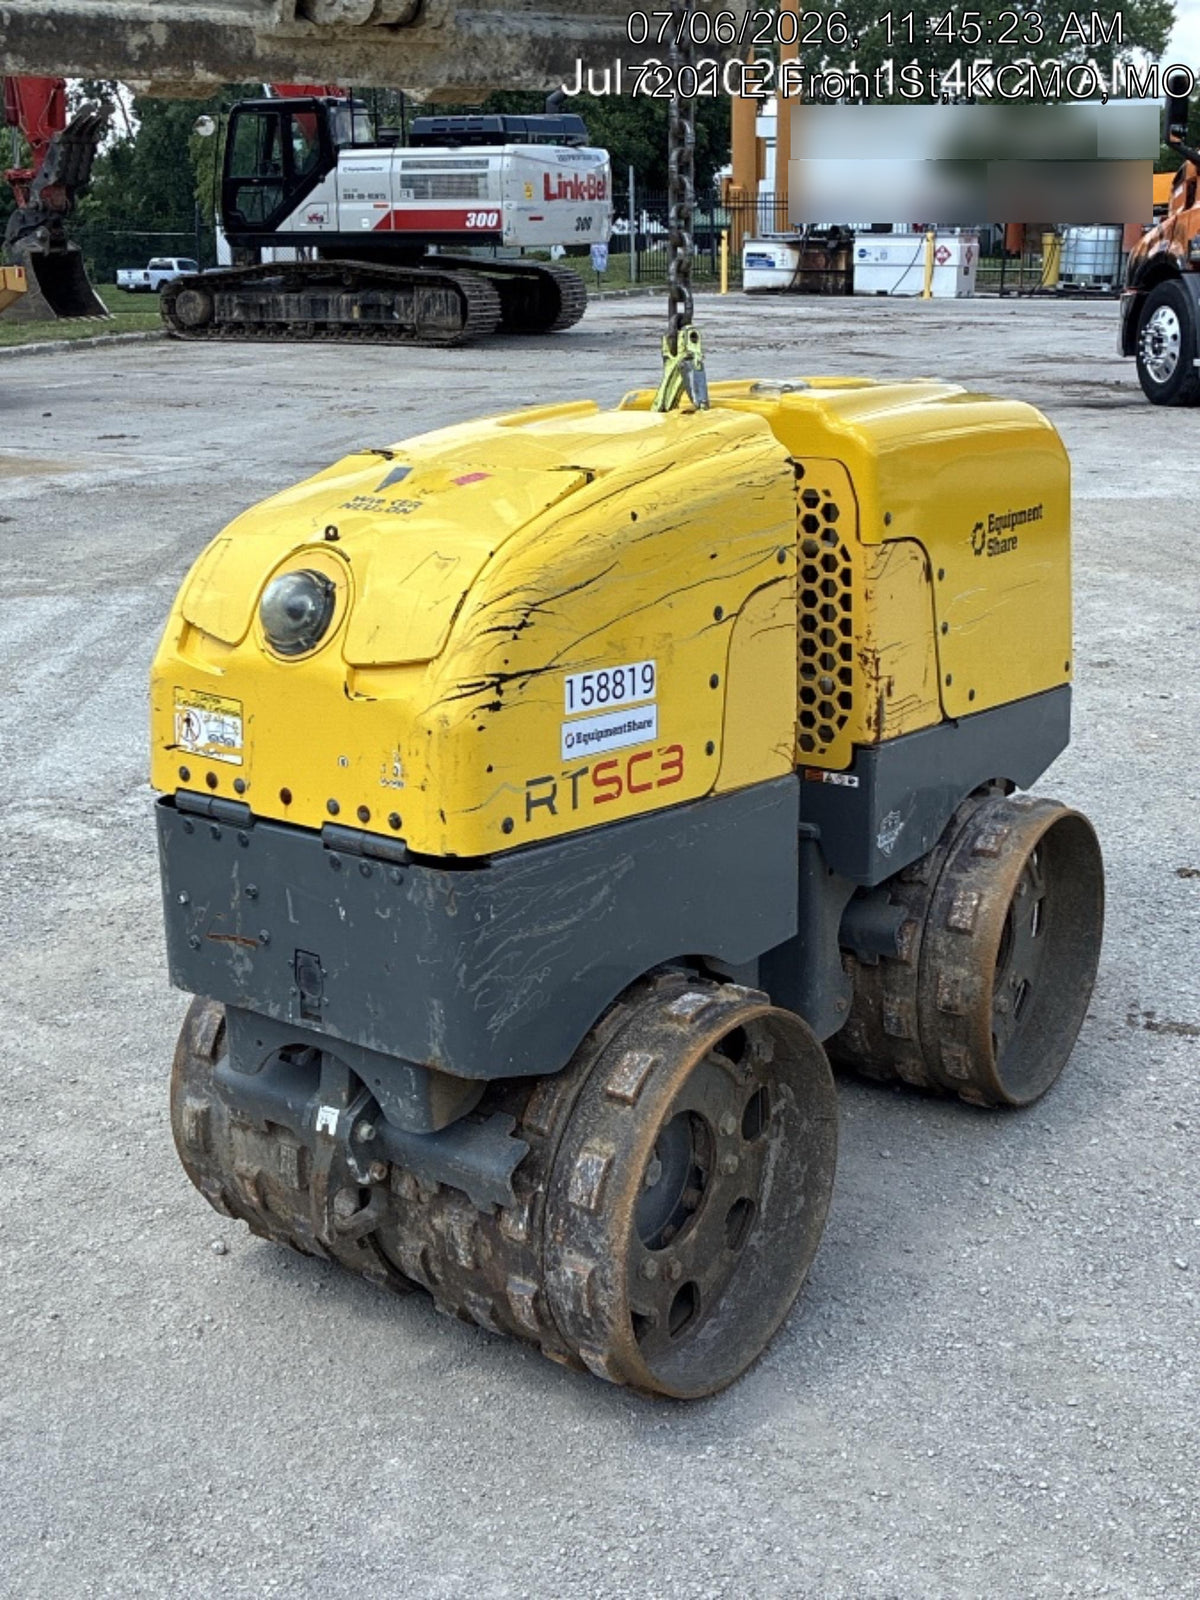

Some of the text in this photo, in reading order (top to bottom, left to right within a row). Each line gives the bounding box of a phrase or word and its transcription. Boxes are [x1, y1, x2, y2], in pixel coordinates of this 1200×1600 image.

[543, 172, 608, 201] Link-Bel
[465, 212, 498, 228] 300
[988, 503, 1043, 535] Equipment
[987, 535, 1018, 557] Share
[565, 663, 655, 709] 158819
[575, 718, 653, 746] EquipmentShare
